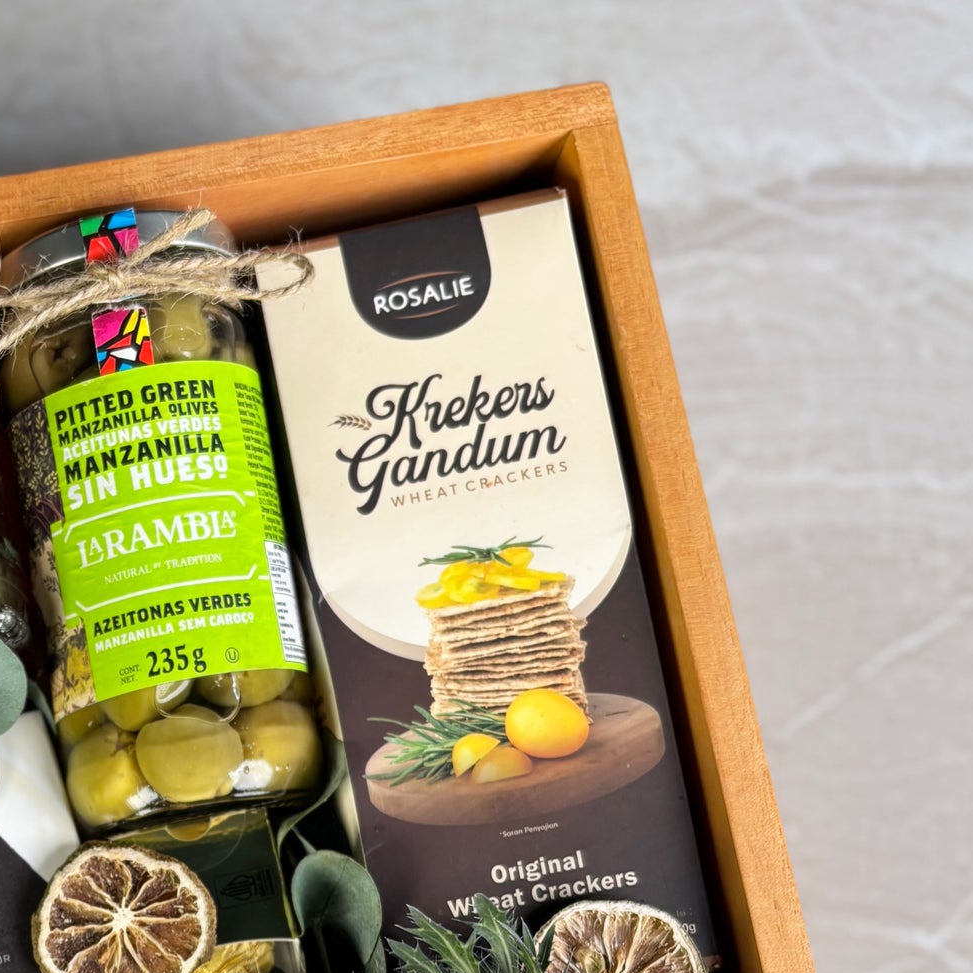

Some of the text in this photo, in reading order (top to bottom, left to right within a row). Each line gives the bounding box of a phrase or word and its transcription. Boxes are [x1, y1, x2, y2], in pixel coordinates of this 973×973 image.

[373, 277, 475, 315] ROSALIE
[54, 379, 216, 431] PITTED GREEN
[58, 401, 219, 447] MANZANILLA OLIVES
[365, 373, 555, 449] Krekers
[62, 416, 222, 463] ACEITUNAS VERDES
[63, 433, 225, 485] MANZANILLA
[66, 472, 118, 511] SIN
[335, 423, 567, 515] Gandum
[390, 460, 568, 508] WHEAT CRACKERS
[104, 565, 153, 585] NATURAL
[164, 553, 223, 570] TRADITION
[93, 592, 252, 637] AZEITONAS VERDES
[94, 622, 175, 654] MANZANILLA
[178, 615, 206, 633] SEM
[490, 850, 584, 884] Original
[531, 870, 638, 902] Crackers
